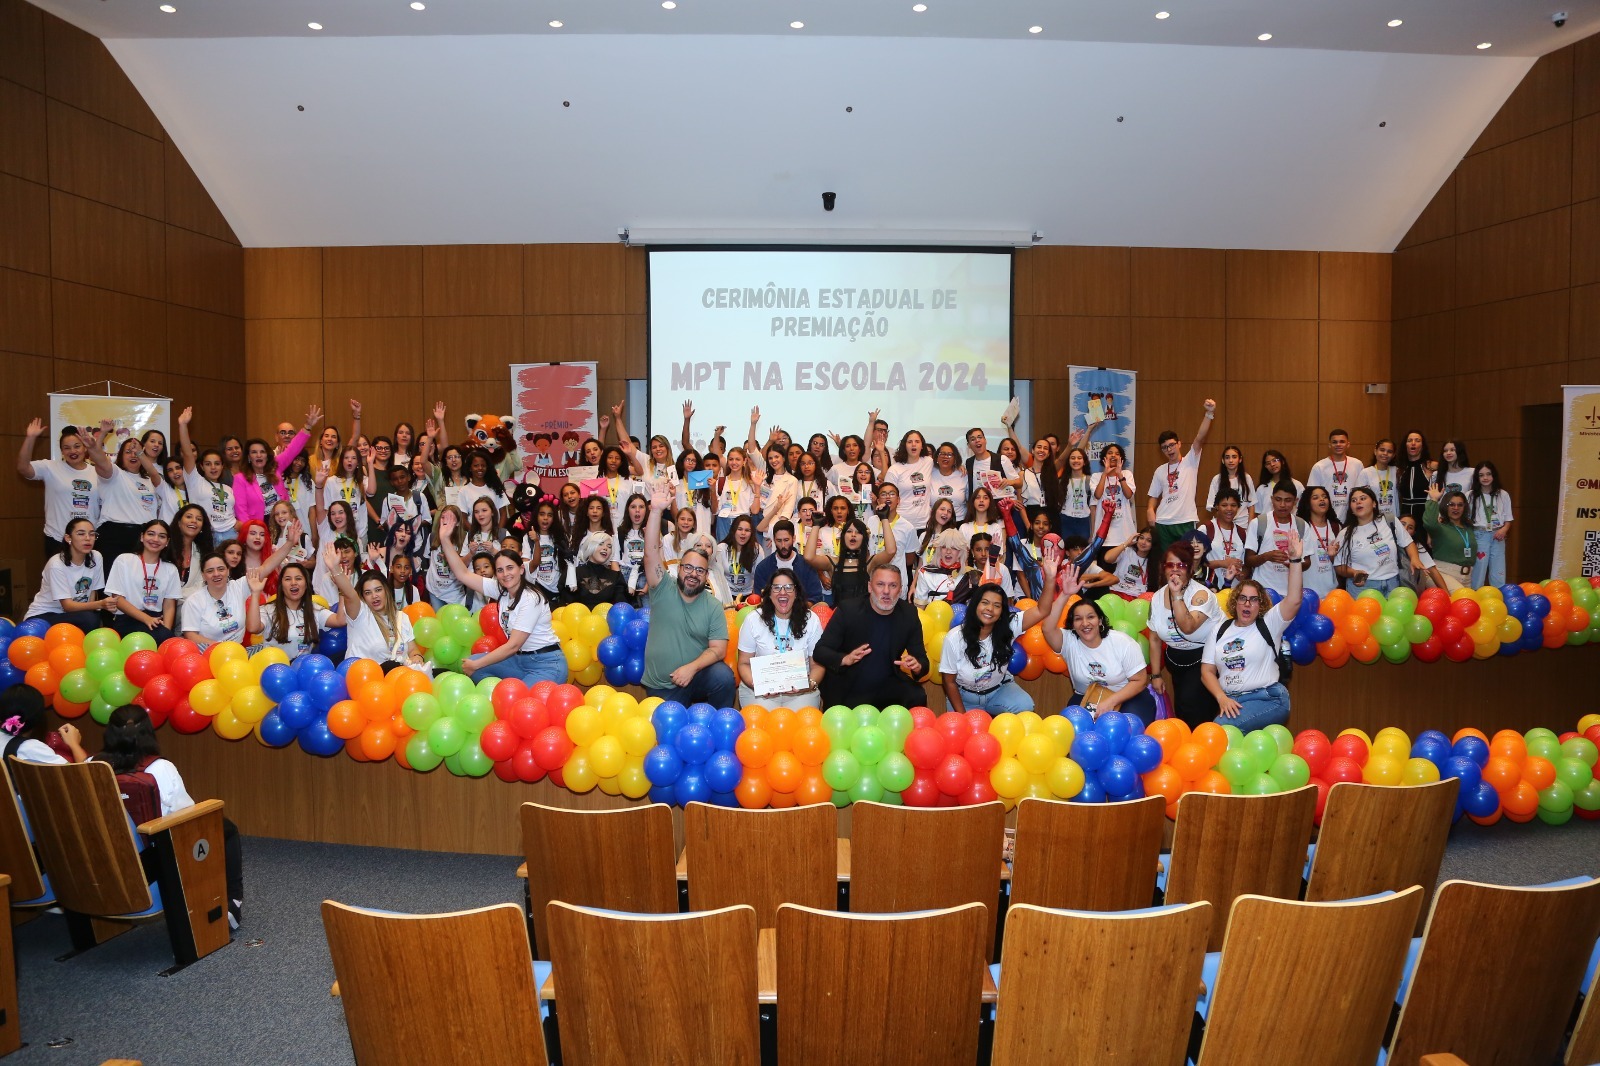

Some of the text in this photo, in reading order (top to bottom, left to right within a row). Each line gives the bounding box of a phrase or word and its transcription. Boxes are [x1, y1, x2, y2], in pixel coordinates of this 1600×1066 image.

[702, 281, 958, 309] CERIMÔNIA ESTADUAL DE
[771, 311, 889, 342] PREMIAÇÃO
[671, 361, 988, 391] MPT NA ESCOLA 2024
[545, 420, 568, 429] PRÊMIO
[548, 468, 557, 477] NA
[1576, 478, 1600, 489] @M
[197, 843, 206, 858] A
